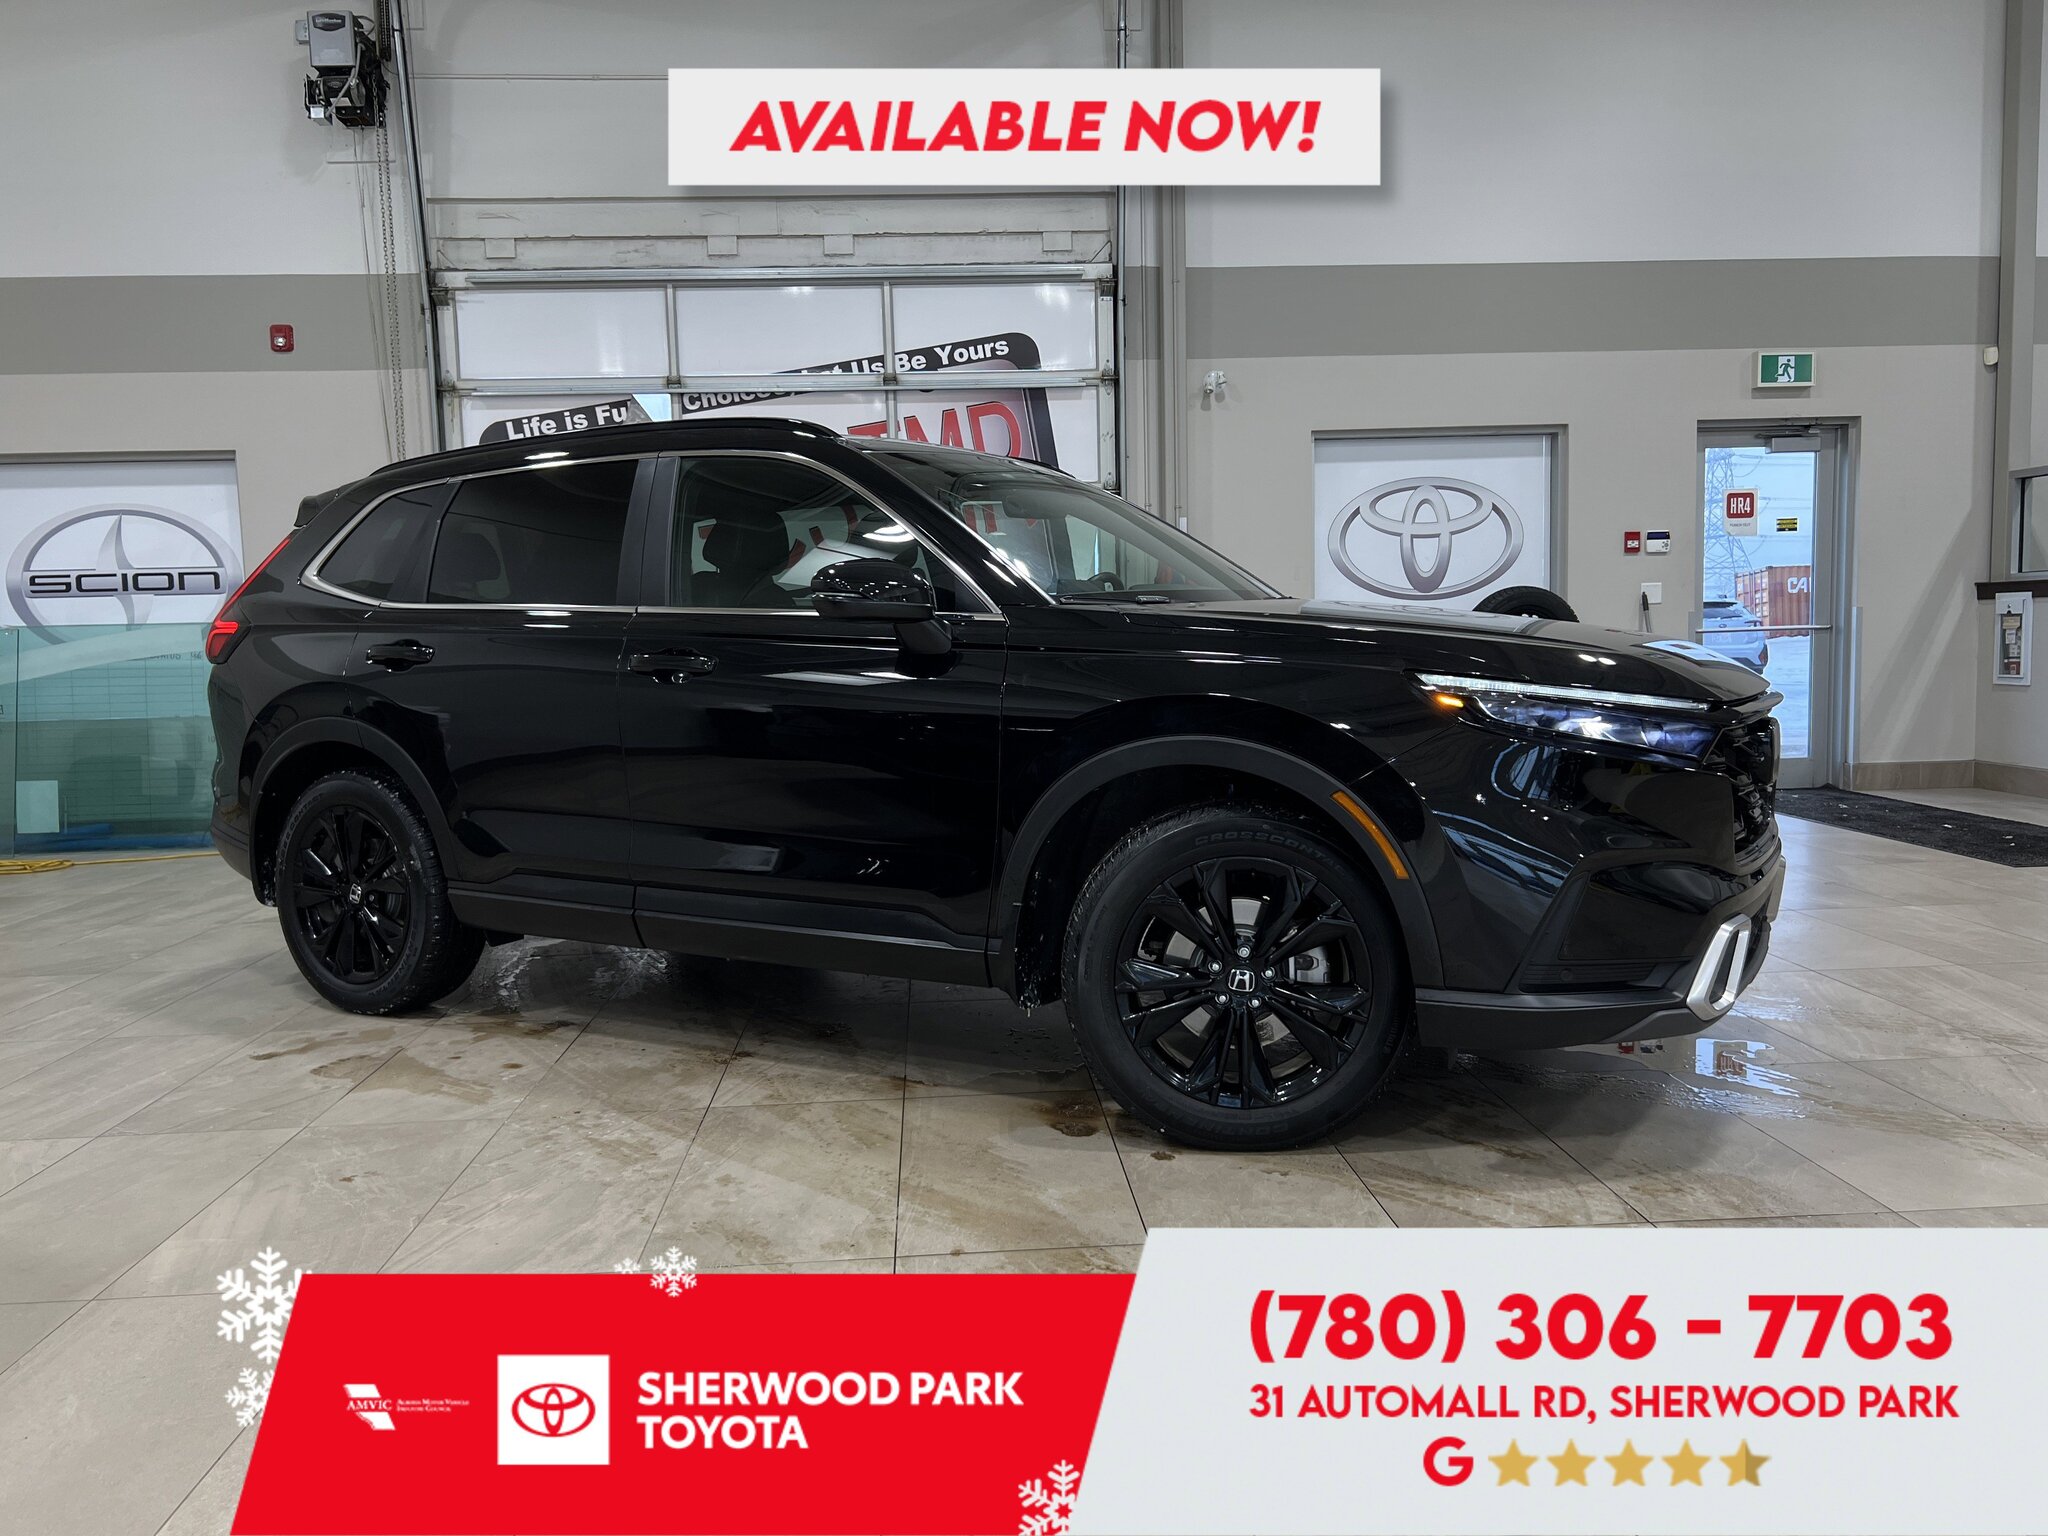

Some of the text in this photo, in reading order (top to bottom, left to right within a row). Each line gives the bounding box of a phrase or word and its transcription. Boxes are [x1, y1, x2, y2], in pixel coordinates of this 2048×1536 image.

[506, 416, 557, 440] Life
[563, 411, 589, 431] is
[595, 402, 632, 425] Fu
[682, 390, 796, 411] Choic,
[894, 353, 927, 372] Be
[933, 338, 1010, 366] Yours
[1729, 497, 1751, 514] HR4
[29, 571, 221, 593] SCION
[1787, 576, 1811, 594] CA
